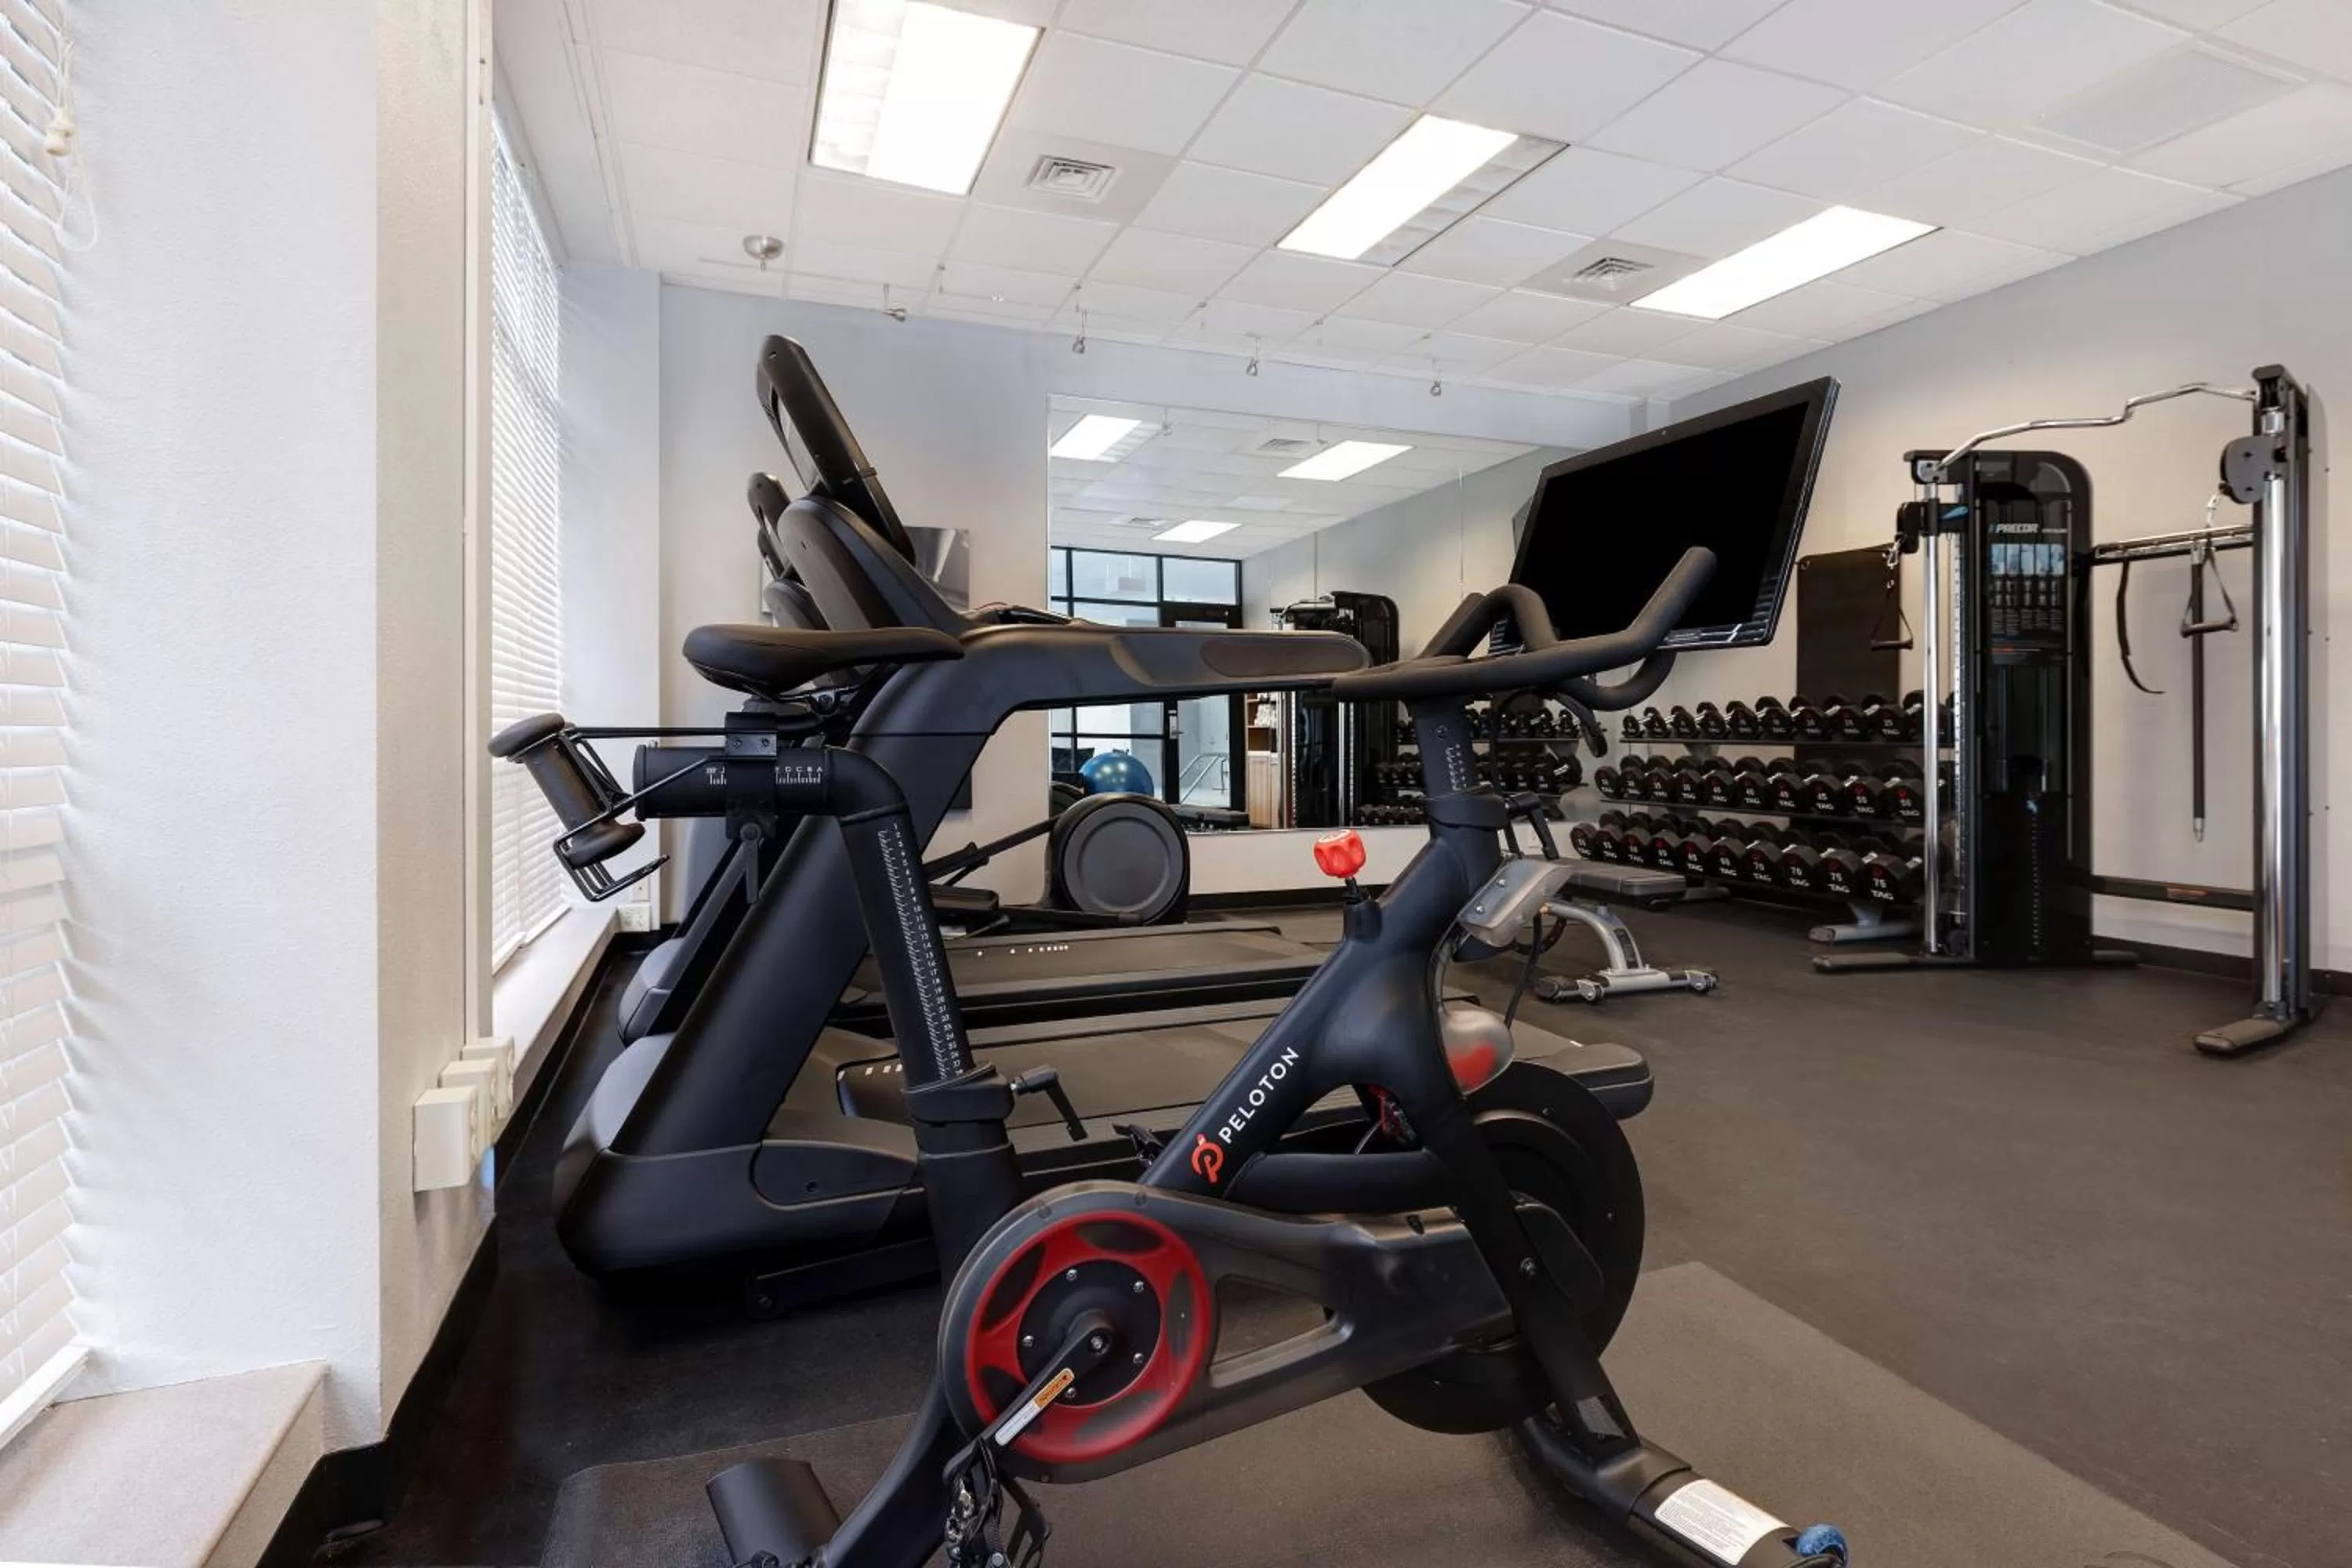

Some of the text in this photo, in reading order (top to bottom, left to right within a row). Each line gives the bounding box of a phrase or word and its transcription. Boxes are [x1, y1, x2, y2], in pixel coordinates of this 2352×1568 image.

[1995, 523, 2039, 534] PRECOR
[1871, 890, 1894, 901] TAG
[1218, 1046, 1299, 1144] PELOTON
